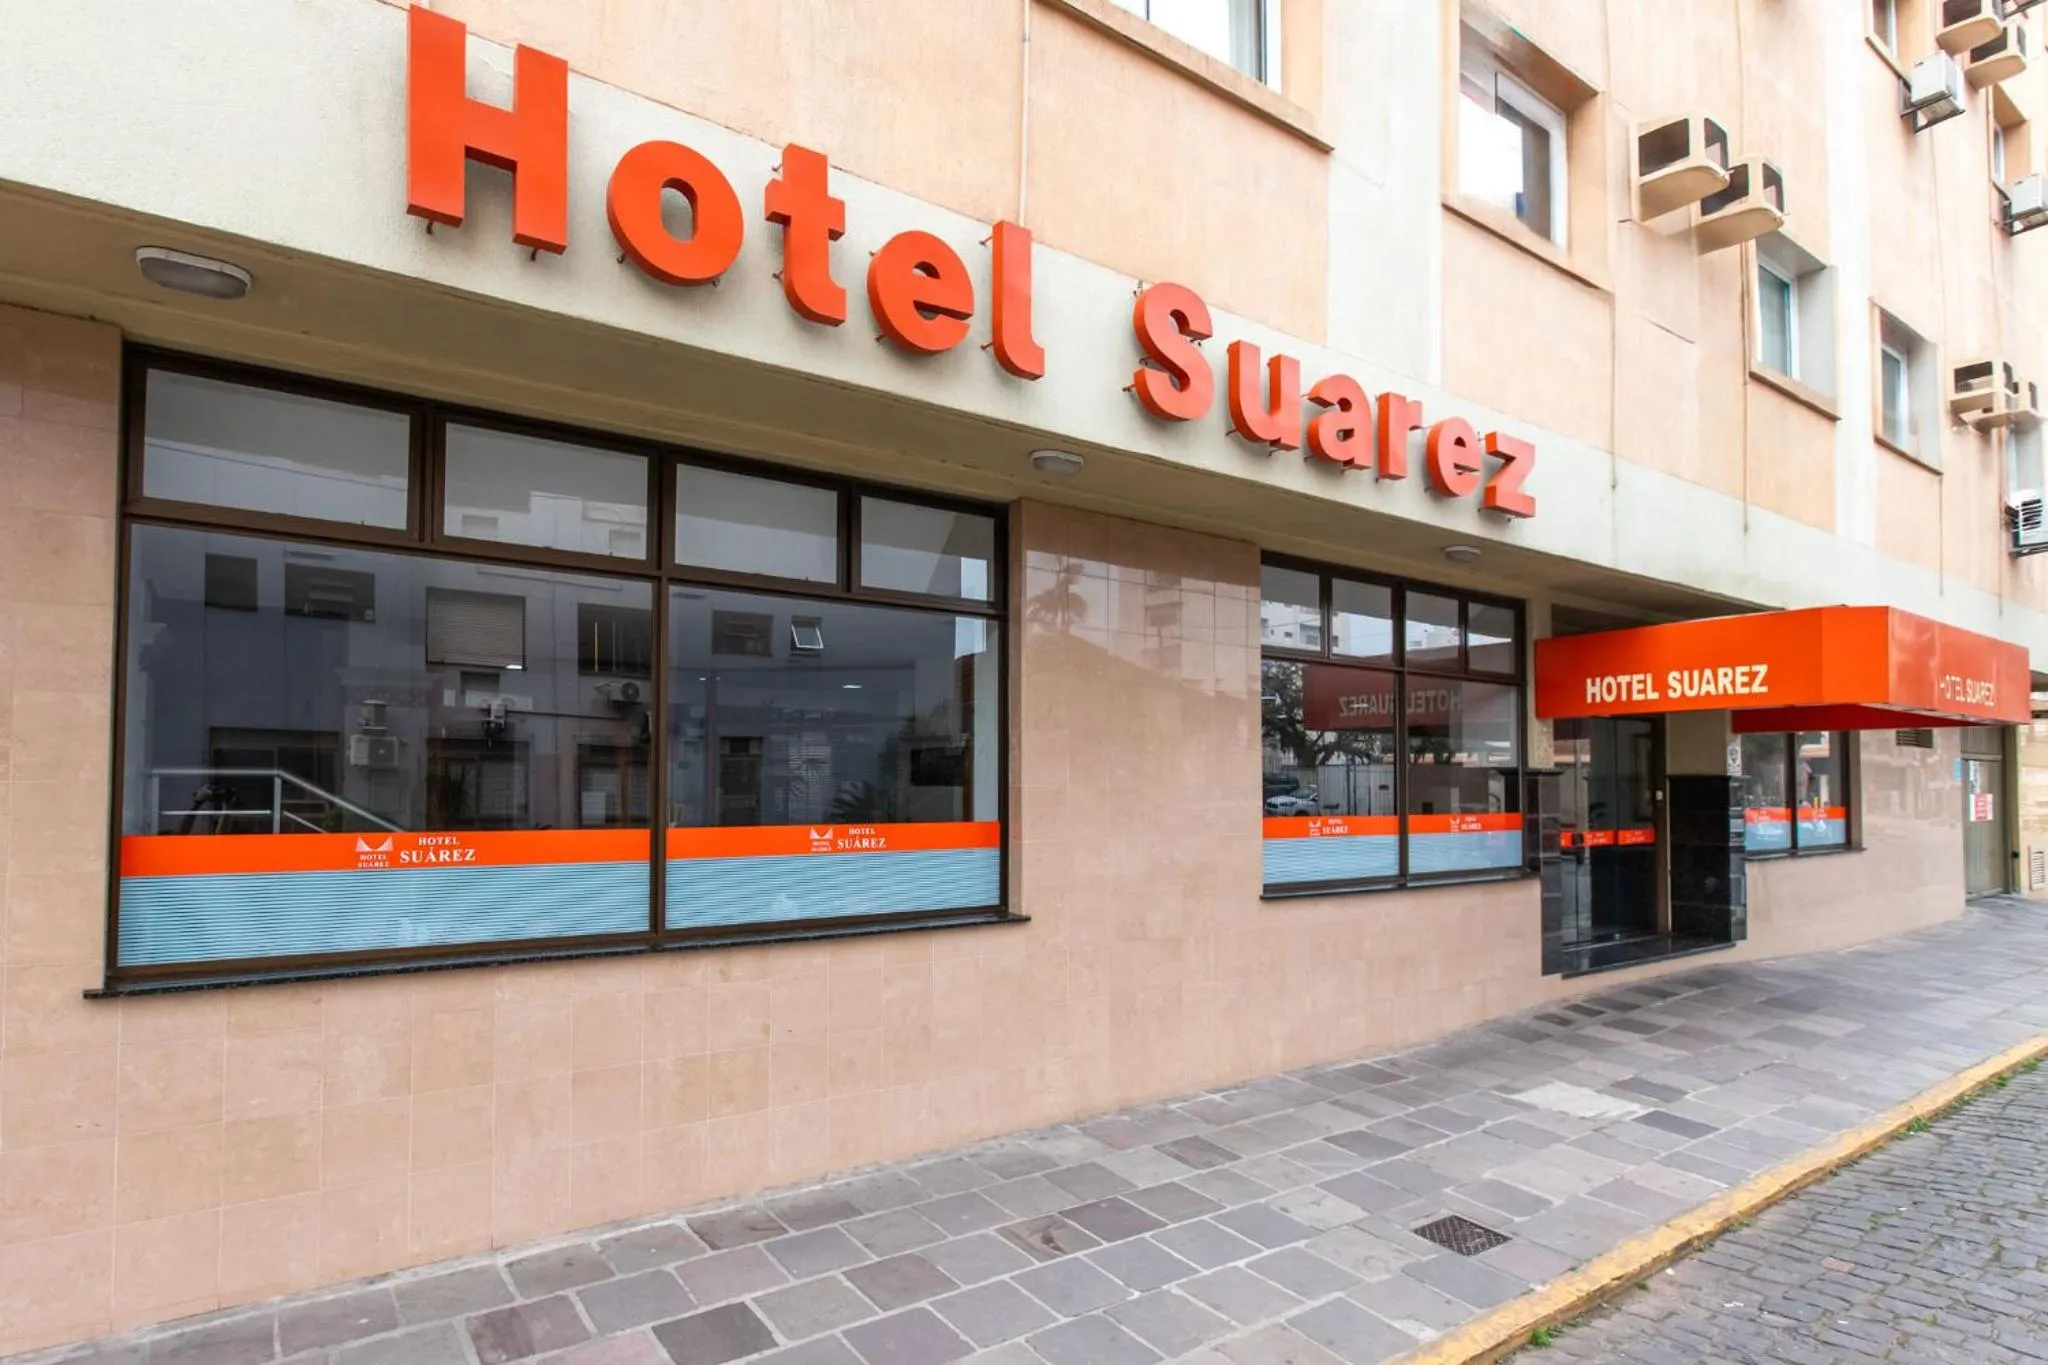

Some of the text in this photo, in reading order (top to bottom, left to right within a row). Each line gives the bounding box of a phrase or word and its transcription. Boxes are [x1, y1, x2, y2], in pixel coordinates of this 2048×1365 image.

[407, 4, 1536, 518] Hotel Suarez
[1585, 664, 1769, 704] HOTEL SUAREZ
[848, 827, 876, 835] HOTEL
[418, 836, 461, 846] HOTEL
[837, 835, 887, 849] SUÁREZ
[400, 847, 476, 863] SUÁREZ
